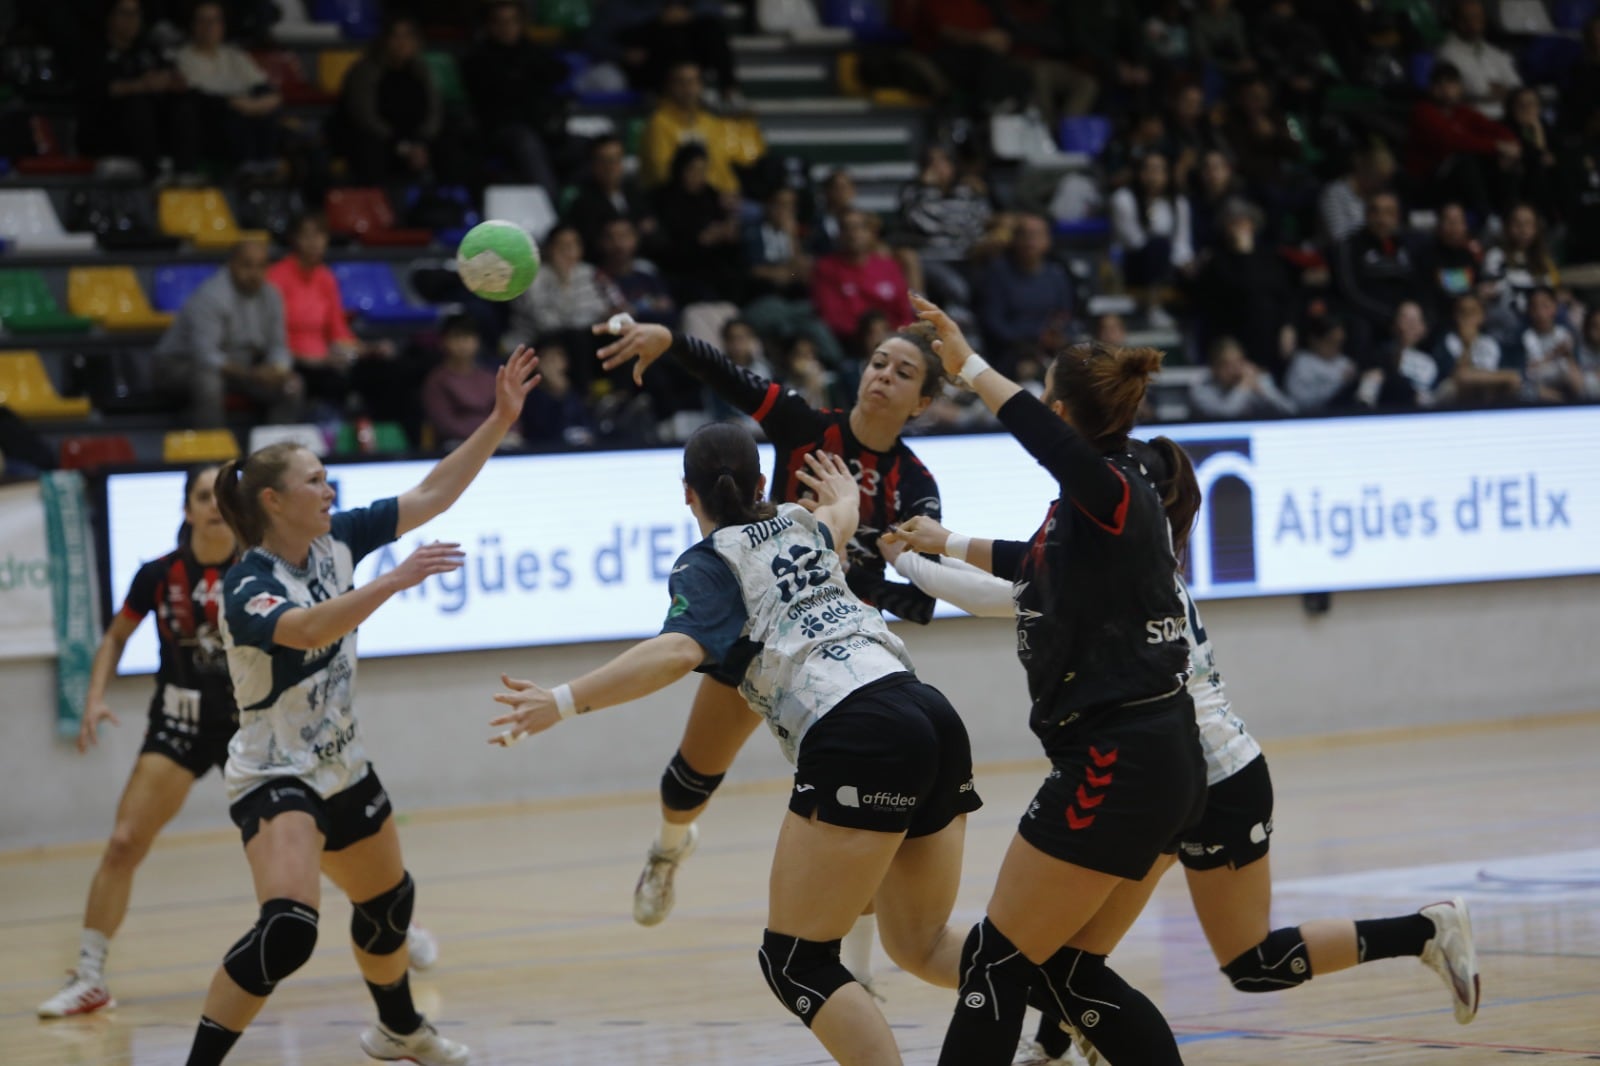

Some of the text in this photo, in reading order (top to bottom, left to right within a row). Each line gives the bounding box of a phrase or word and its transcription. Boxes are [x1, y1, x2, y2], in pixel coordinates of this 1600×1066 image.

[1273, 472, 1572, 557] Aigües d'Elx
[862, 792, 917, 807] affidea
